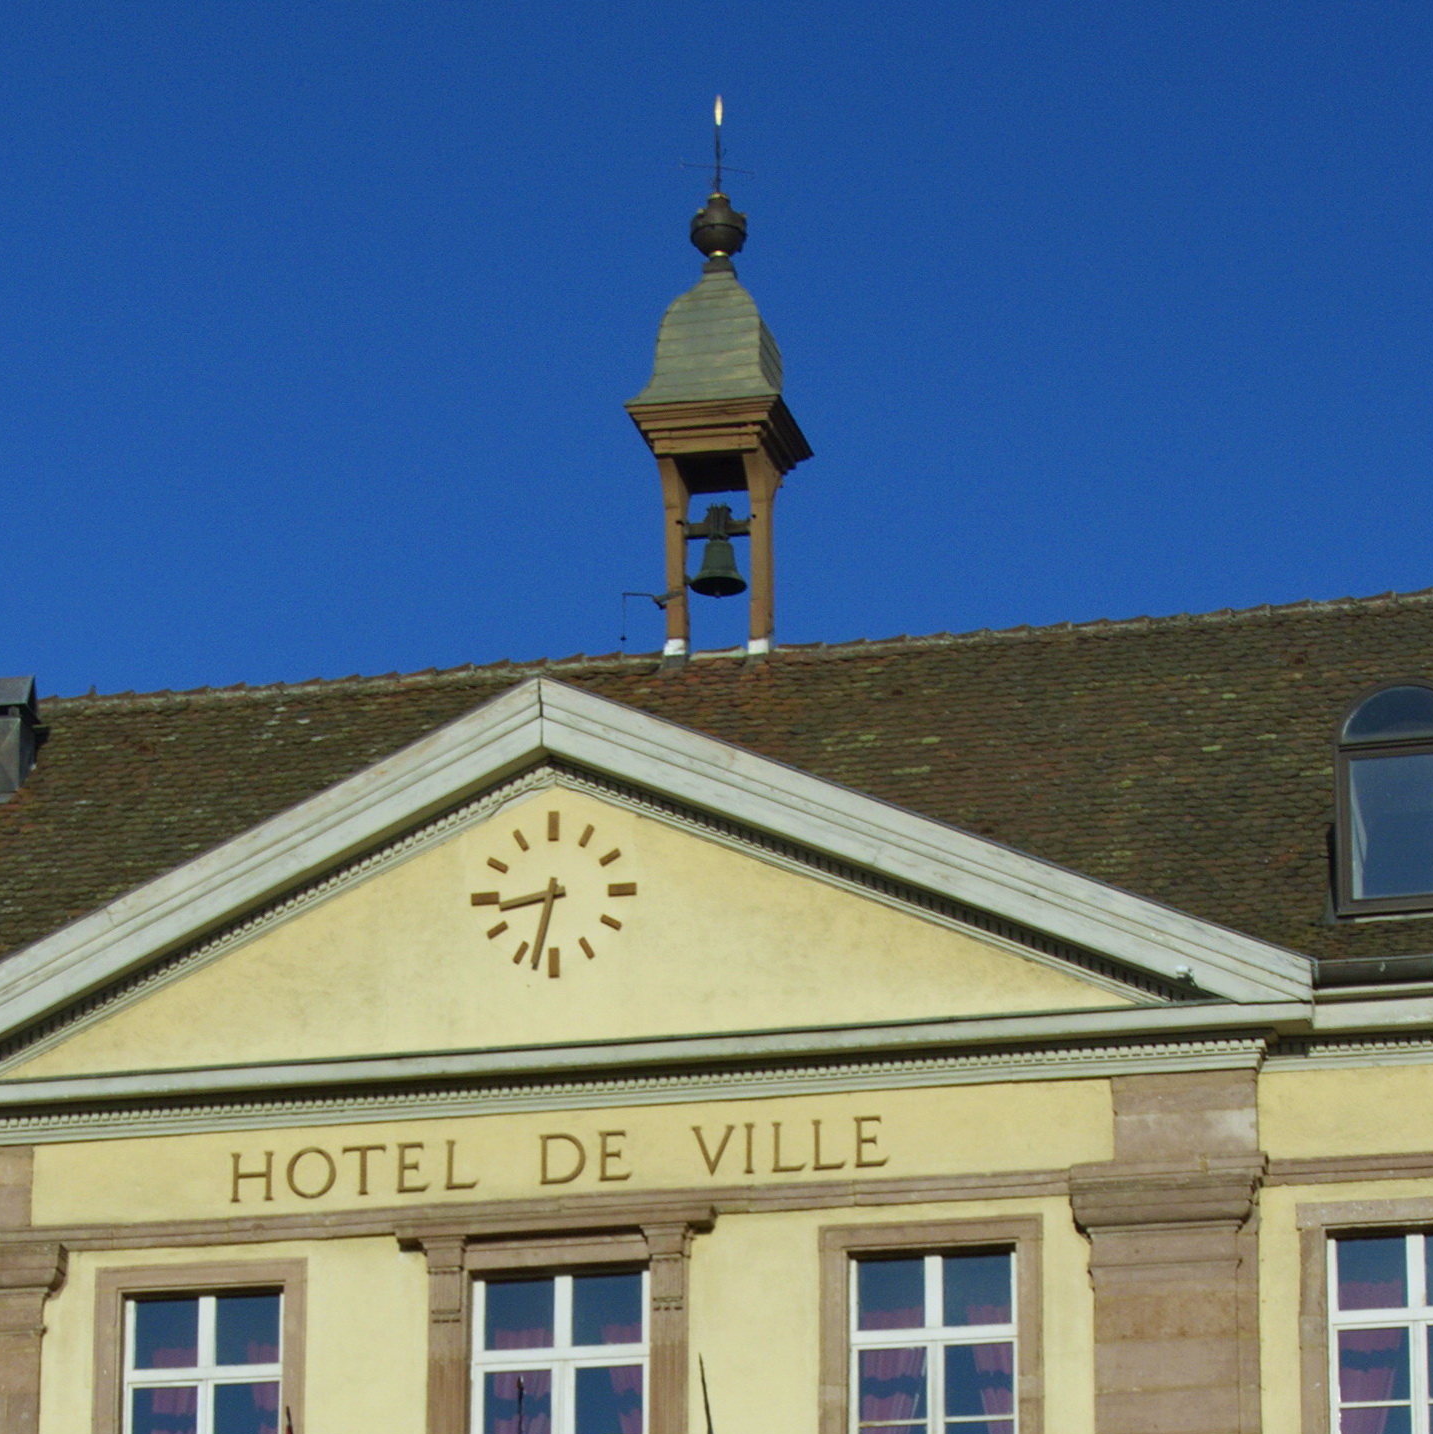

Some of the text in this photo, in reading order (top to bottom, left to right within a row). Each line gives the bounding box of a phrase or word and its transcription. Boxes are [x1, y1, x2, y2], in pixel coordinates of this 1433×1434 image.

[230, 1115, 890, 1204] HOTEL DE VILLE
